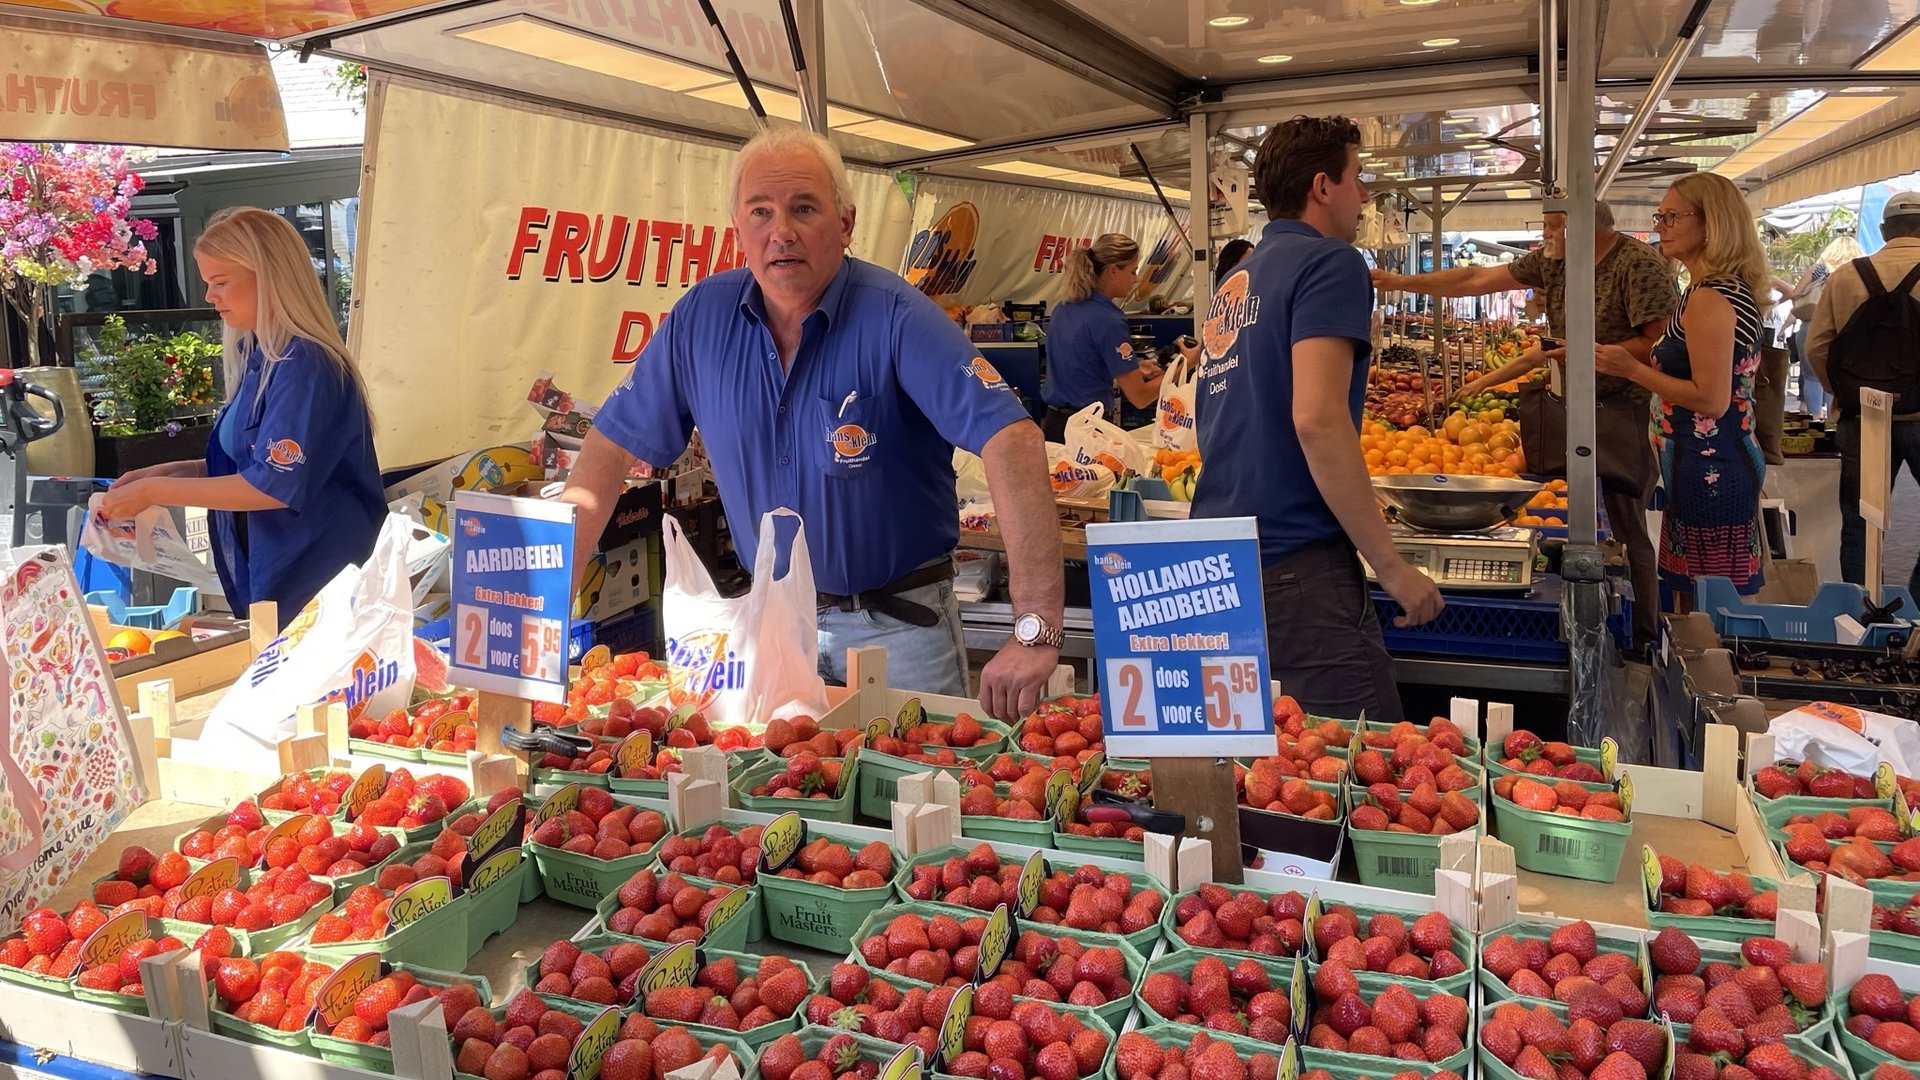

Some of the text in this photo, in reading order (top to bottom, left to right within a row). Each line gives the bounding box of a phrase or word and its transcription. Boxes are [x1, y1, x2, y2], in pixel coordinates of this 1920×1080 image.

[506, 206, 748, 288] FRUITHA
[1202, 354, 1239, 379] Fruithandel
[465, 543, 565, 575] AARDBEIEN
[1107, 552, 1236, 604] HOLLANDSE
[474, 585, 545, 612] Extra lekker!
[1117, 582, 1242, 633] AARDBEIEN
[464, 611, 483, 666] 2
[489, 616, 513, 639] doos
[1129, 632, 1230, 652] Extra lekker!
[489, 648, 512, 668] voor
[1155, 666, 1190, 689] doos
[1118, 664, 1146, 727] 2
[1161, 705, 1192, 725] voor
[33, 841, 64, 873] come
[65, 814, 95, 844] true
[553, 877, 605, 900] Masters
[566, 872, 601, 891] Fruit
[794, 904, 833, 926] Fruit
